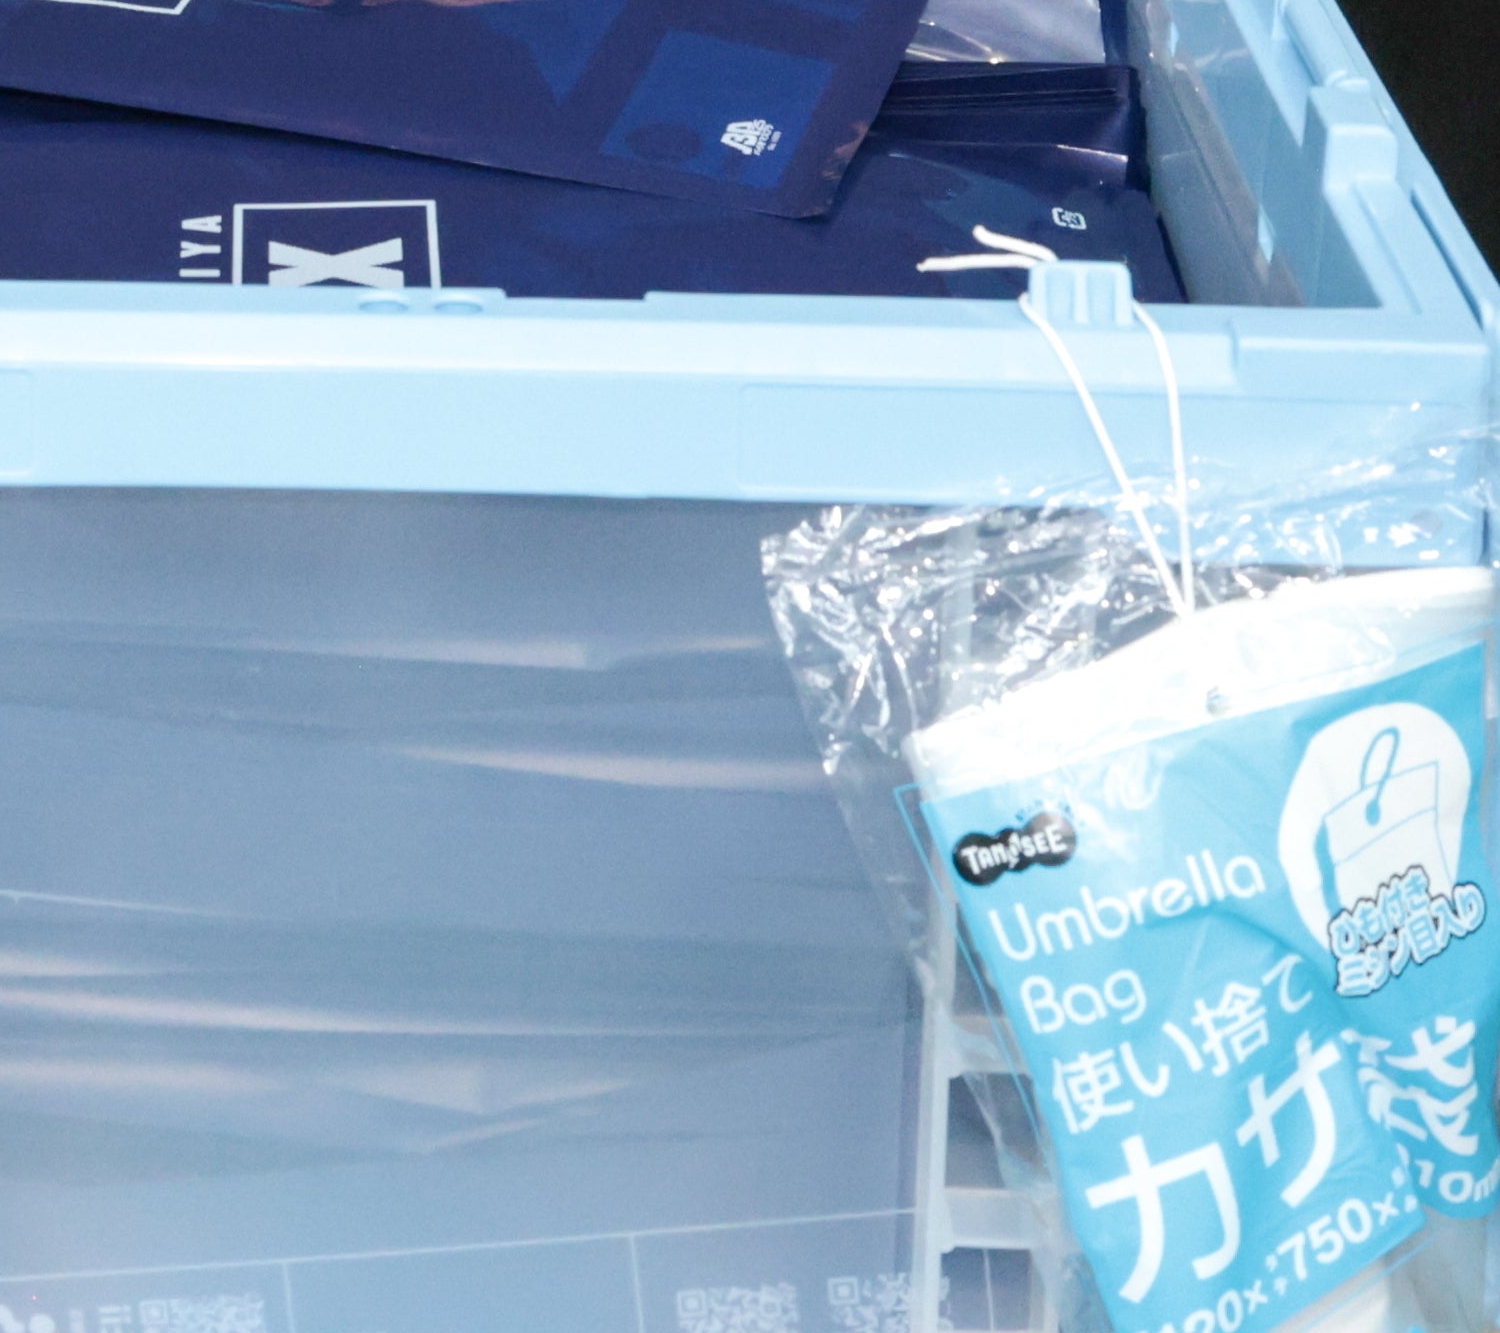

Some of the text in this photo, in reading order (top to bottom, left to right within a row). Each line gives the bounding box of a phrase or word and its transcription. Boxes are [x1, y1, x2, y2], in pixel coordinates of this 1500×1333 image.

[988, 848, 1267, 963] Umbrella
[1018, 967, 1149, 1034] Bag
[1050, 953, 1314, 1134] 使い捨て
